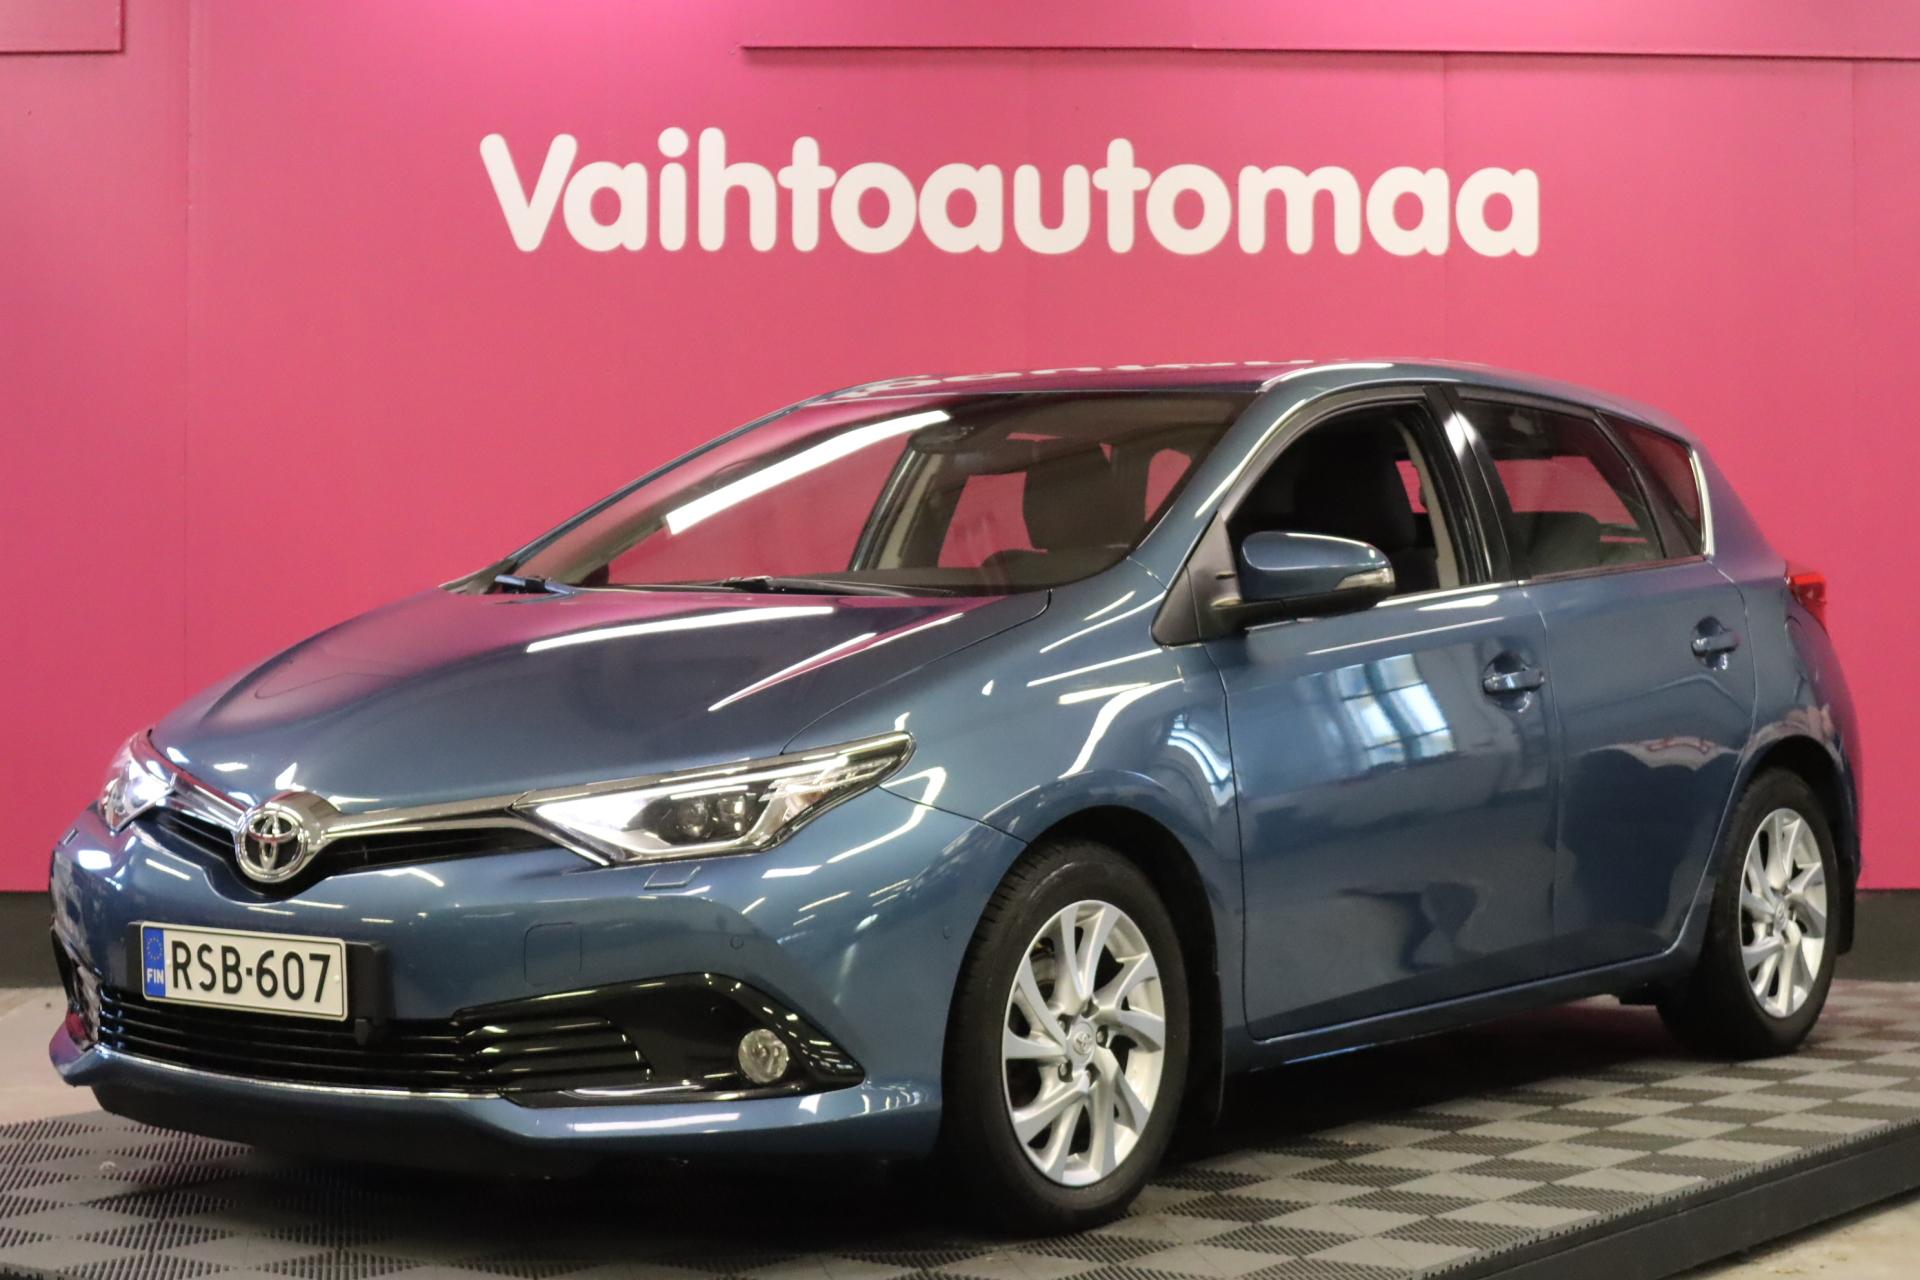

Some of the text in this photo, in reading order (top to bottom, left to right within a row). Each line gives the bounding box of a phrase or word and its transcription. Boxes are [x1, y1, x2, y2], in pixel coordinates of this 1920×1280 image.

[480, 126, 1540, 258] Vaihtoautomaa
[146, 968, 164, 985] FIN
[171, 940, 331, 1003] RSB-607
